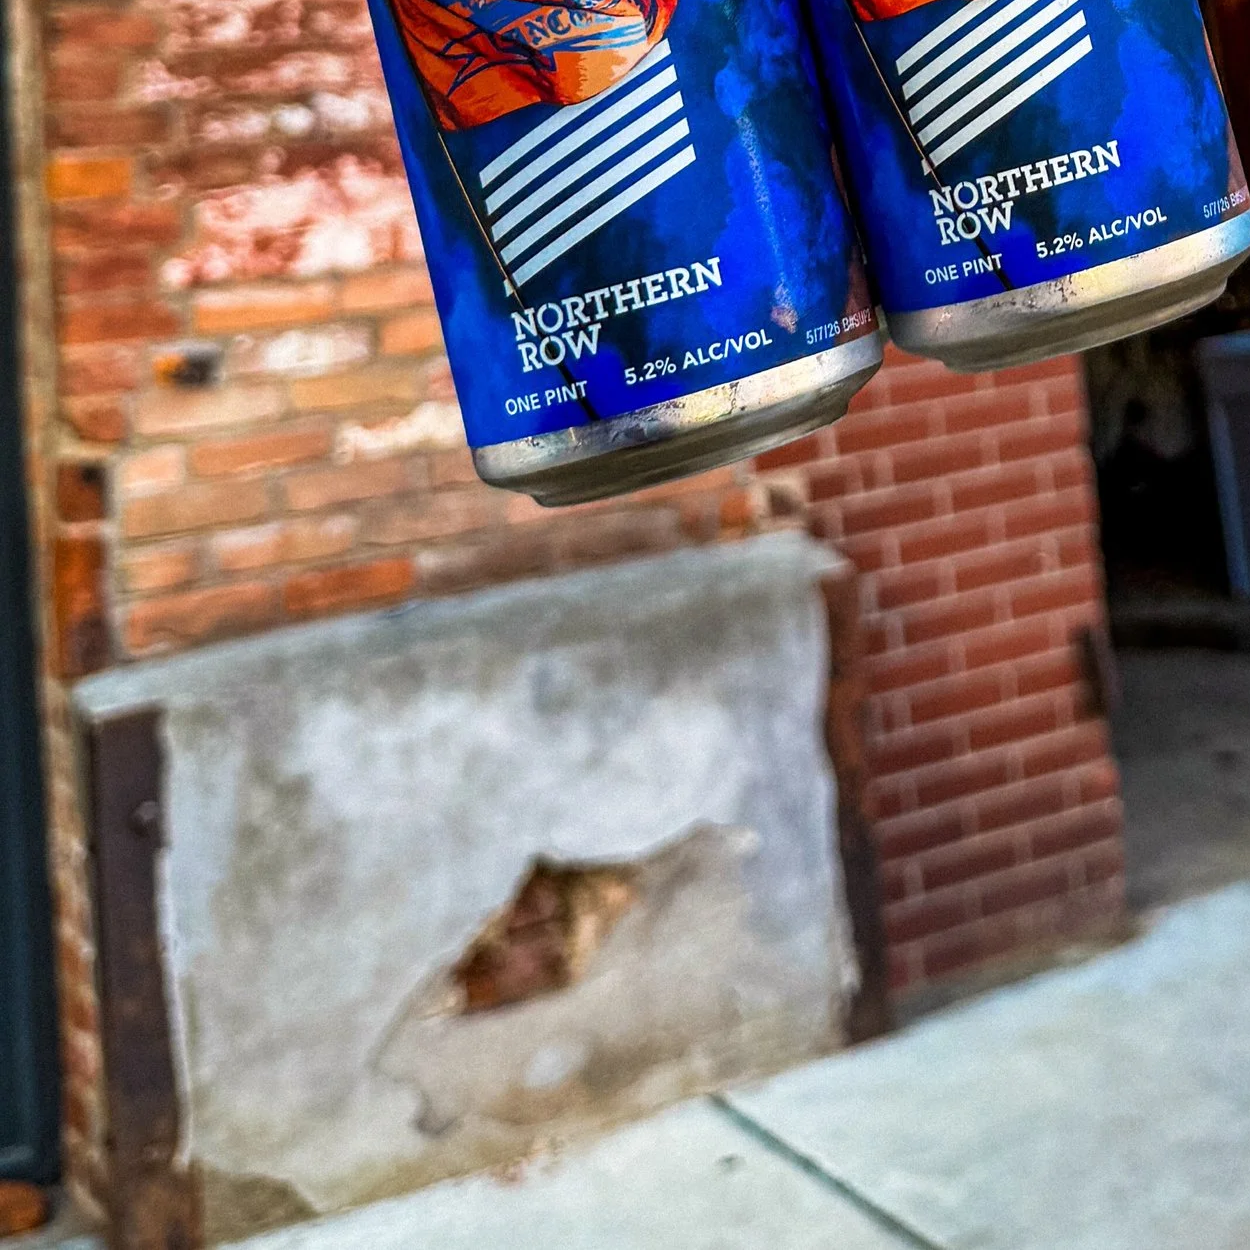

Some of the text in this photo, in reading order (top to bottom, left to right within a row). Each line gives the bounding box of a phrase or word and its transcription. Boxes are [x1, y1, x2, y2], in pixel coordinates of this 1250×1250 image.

[928, 140, 1122, 217] NORTHERN
[936, 200, 1014, 246] ROW
[1036, 207, 1167, 259] 5.2% ALC/VOL
[925, 254, 1003, 285] ONE PINT
[511, 257, 723, 340] NORTHERN
[518, 323, 602, 373] ROW
[624, 328, 773, 385] 5.2% ALC/VOL
[505, 381, 588, 416] ONE PINT
